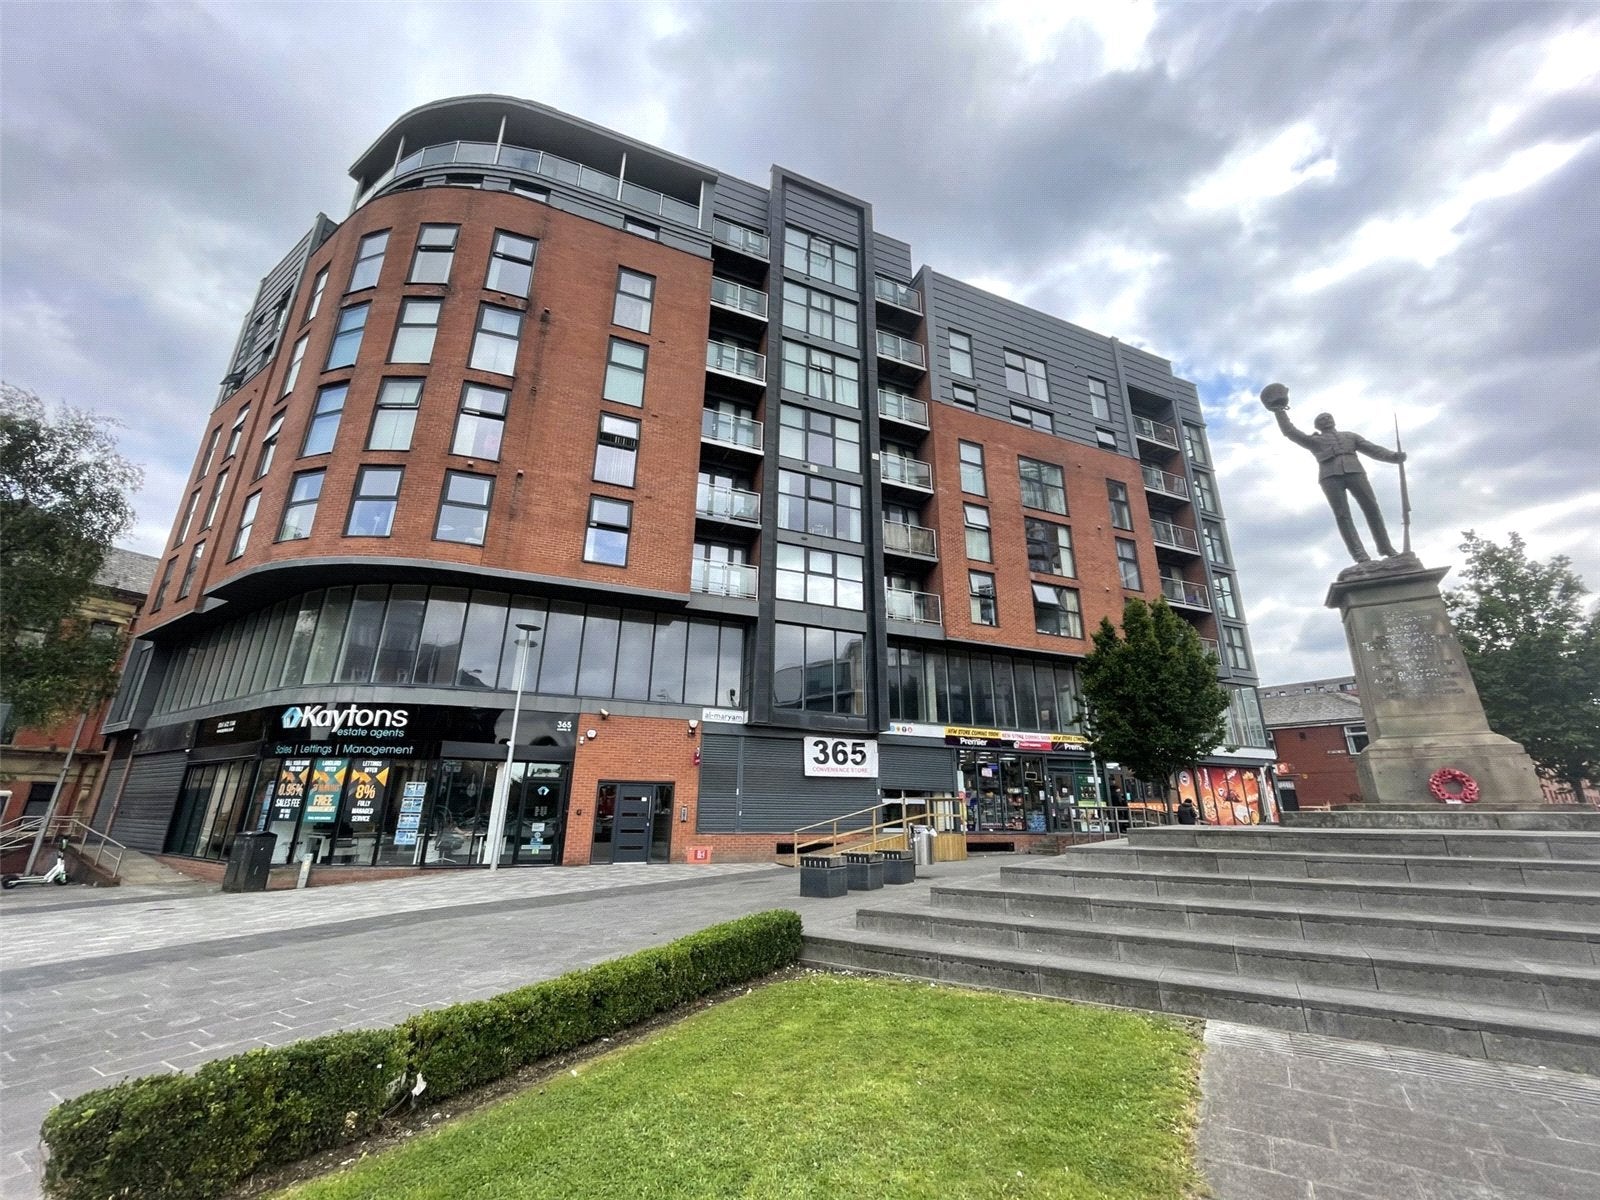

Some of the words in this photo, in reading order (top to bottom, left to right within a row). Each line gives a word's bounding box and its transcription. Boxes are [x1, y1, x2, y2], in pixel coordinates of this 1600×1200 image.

[300, 704, 408, 733] Kaytons
[557, 720, 572, 728] 365
[337, 728, 367, 736] estate
[370, 728, 405, 738] agents
[960, 737, 988, 746] Premier
[275, 745, 293, 754] Sales
[300, 744, 332, 755] Lettings
[342, 744, 414, 755] Management
[812, 739, 867, 766] 365
[355, 784, 376, 799] 8%
[275, 798, 291, 807] SALES
[291, 798, 301, 807] FEE
[351, 815, 371, 823] SERVICE
